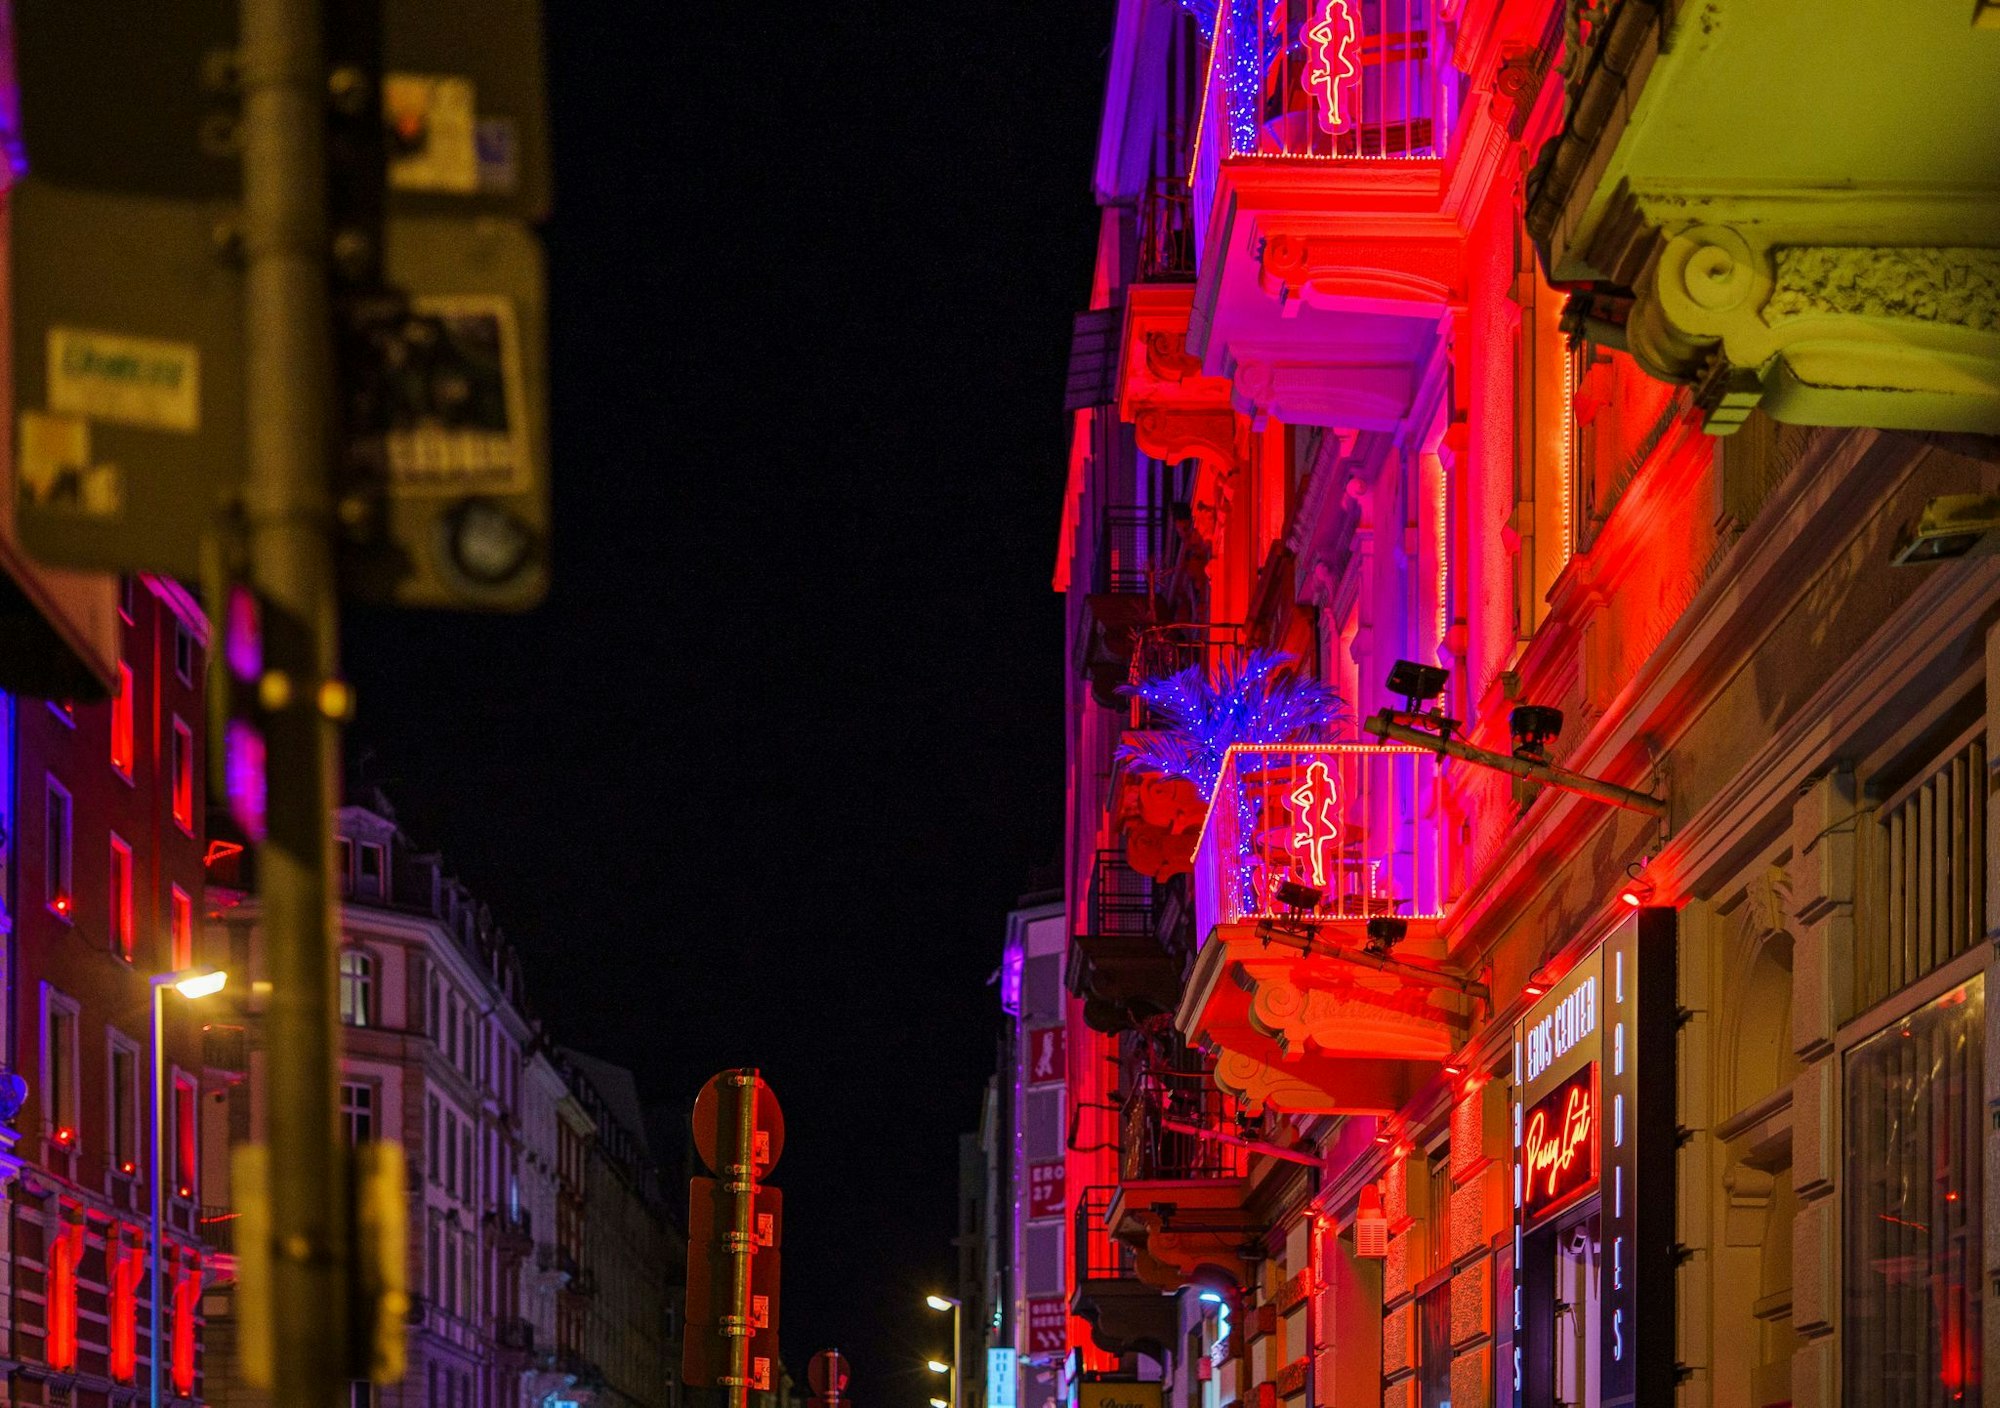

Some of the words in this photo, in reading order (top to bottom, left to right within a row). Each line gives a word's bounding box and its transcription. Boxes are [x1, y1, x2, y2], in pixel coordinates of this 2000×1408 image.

[1527, 1014, 1553, 1083] EROS
[1554, 976, 1596, 1058] CENTER
[1561, 1087, 1591, 1170] Cat
[1614, 951, 1624, 1361] LADIES
